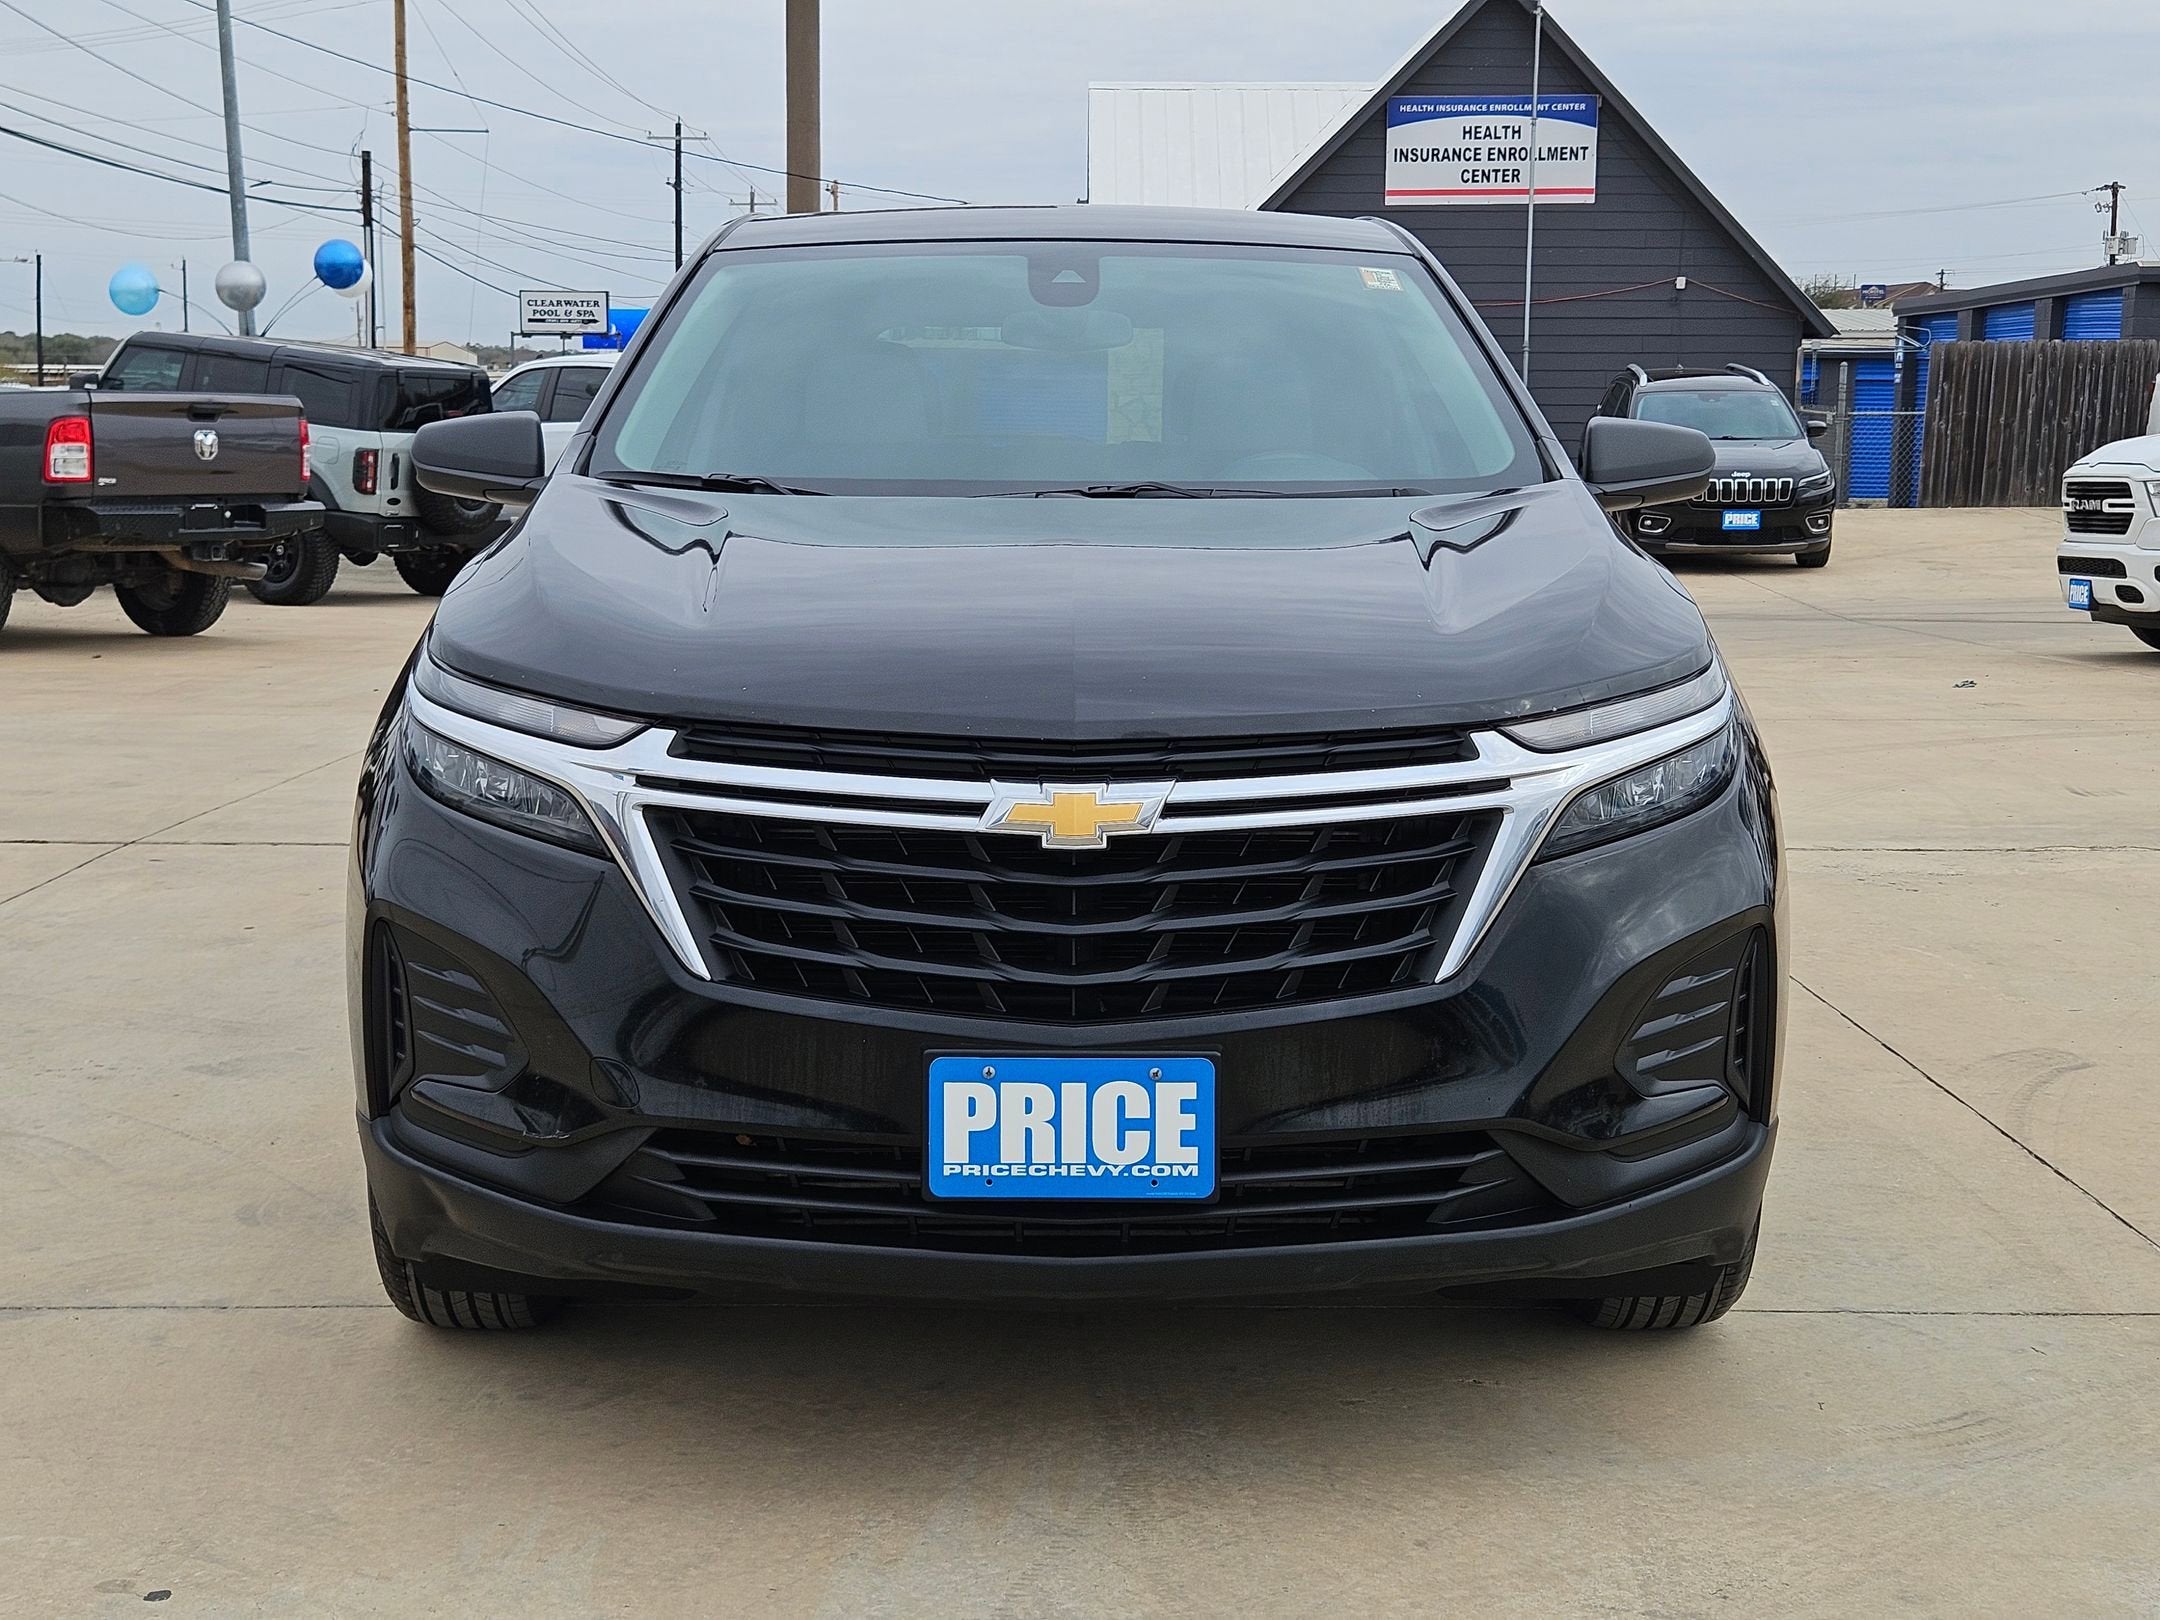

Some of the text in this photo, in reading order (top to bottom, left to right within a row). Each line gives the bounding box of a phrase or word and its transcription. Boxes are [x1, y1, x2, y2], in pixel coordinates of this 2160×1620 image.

[1399, 102, 1587, 112] HEALTH INSURANCE ENROLLMNT CENTER
[1462, 125, 1522, 140] HEALTH
[1393, 147, 1482, 163] INSURANCE
[1460, 168, 1521, 184] CENTER
[526, 299, 600, 308] CLEARWATER
[532, 309, 596, 318] POOL & SPA
[1731, 470, 1751, 478] Jeep
[2070, 499, 2101, 511] RAM
[1724, 513, 1759, 525] PRICE
[2070, 584, 2089, 603] PRICE
[943, 1080, 1199, 1166] PRICE
[943, 1165, 1199, 1177] PRICECHEVY.COM
